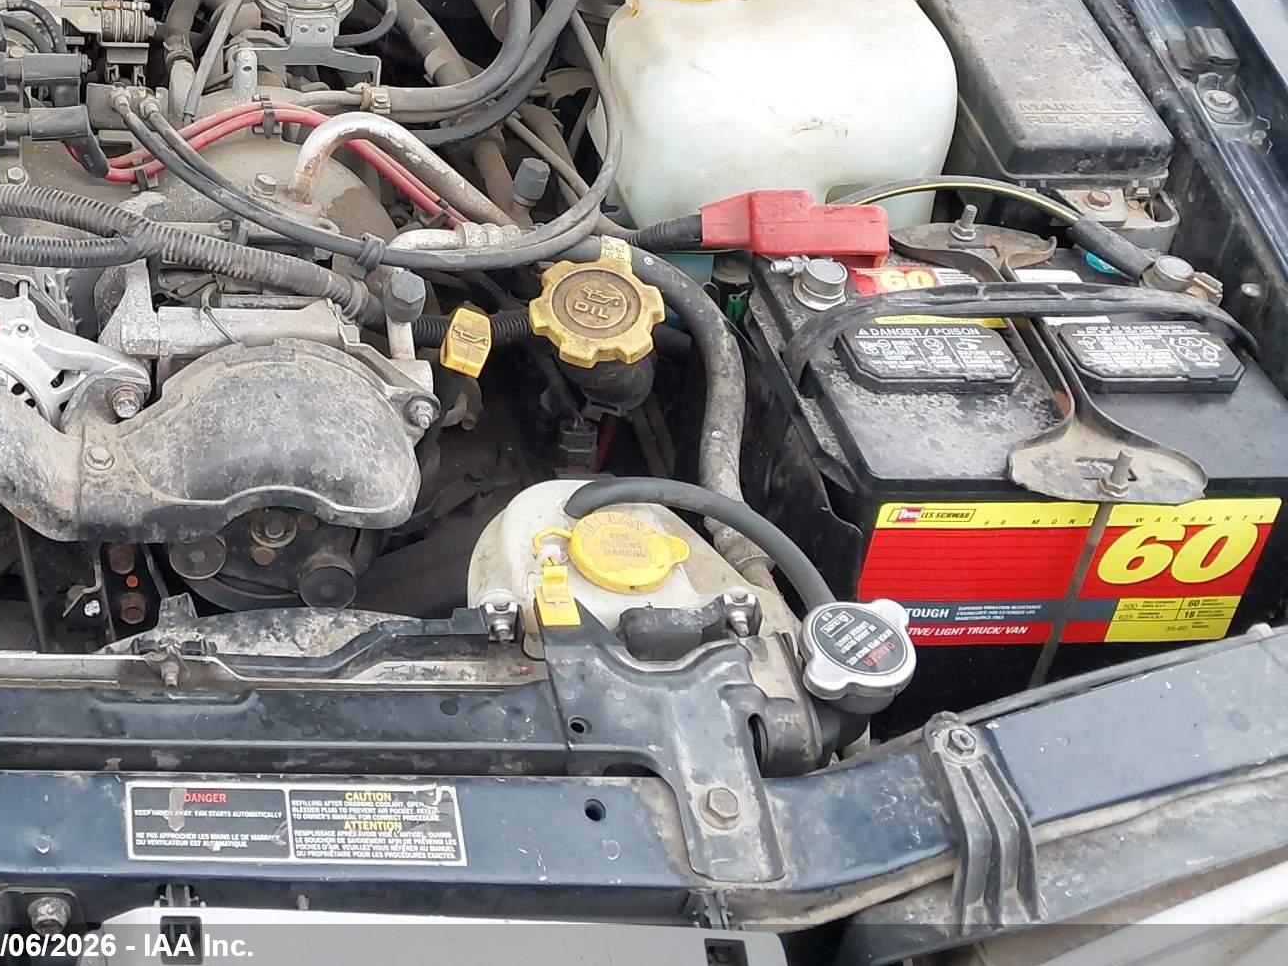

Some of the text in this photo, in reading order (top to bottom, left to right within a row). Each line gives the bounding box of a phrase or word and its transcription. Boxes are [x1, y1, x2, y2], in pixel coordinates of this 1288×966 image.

[1018, 101, 1076, 111] MAIN
[1025, 114, 1150, 125] RELAY BOX
[879, 270, 935, 290] 60
[574, 301, 610, 319] OIL
[1135, 515, 1266, 523] WARRANTY
[1097, 521, 1259, 584] 60
[1187, 599, 1200, 607] 60
[905, 608, 949, 618] TOUGH
[934, 627, 965, 636] LIGHT
[1005, 626, 1029, 634] VAN
[183, 793, 227, 803] DANGER
[344, 791, 392, 802] CAUTION
[343, 820, 402, 831] ATTENTION
